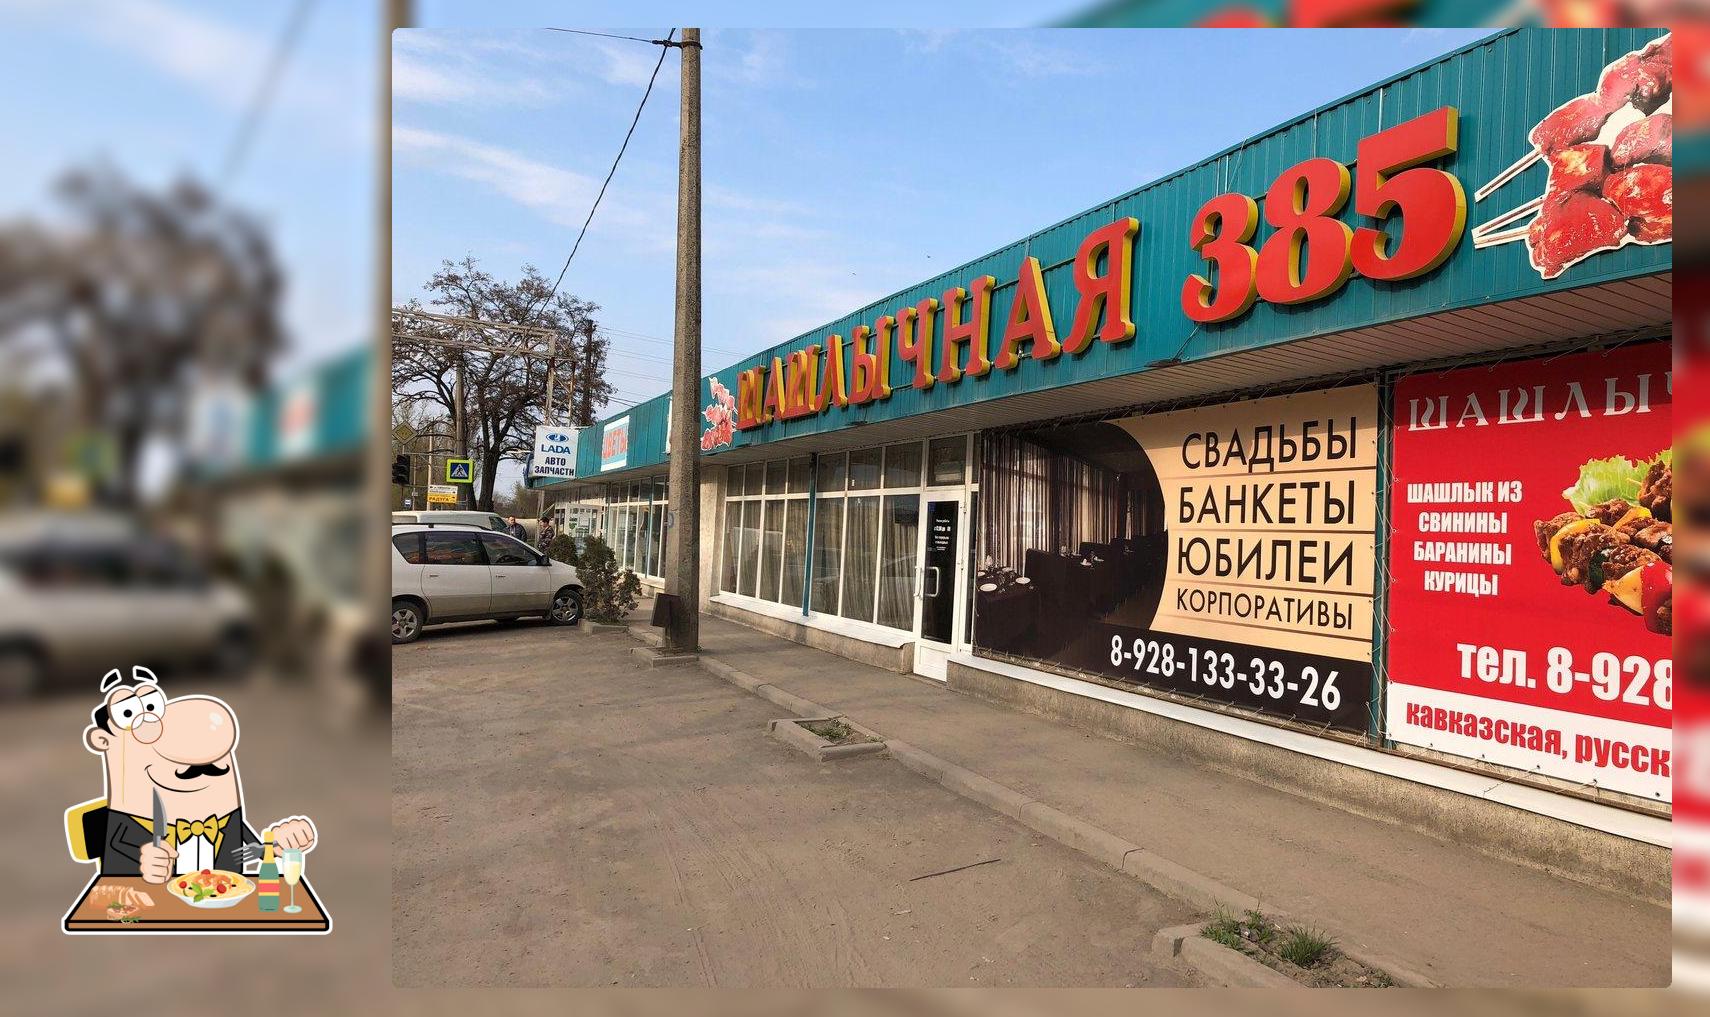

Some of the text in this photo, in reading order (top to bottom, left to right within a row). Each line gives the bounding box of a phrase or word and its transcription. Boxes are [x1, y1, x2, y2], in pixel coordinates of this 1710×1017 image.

[736, 105, 1467, 430] ШАШЛЫЧНАЯ 385
[541, 444, 571, 455] LADA
[545, 457, 566, 467] АВТО
[1182, 416, 1357, 473] СВАДЬБЫ
[534, 465, 575, 477] ЗАПЧАСТИ
[1407, 480, 1523, 503] ШАШЛЫК ИЗ
[1178, 480, 1355, 525] БАНКЕТЫ
[1418, 511, 1508, 534] СВИНИНЫ
[1177, 537, 1354, 586] ЮБИЛЕИ
[1413, 541, 1512, 565] БАРАНИНЫ
[1424, 570, 1499, 598] КУРИЦЫ
[1177, 588, 1353, 630] КОРПОРАТИВЫ
[1110, 635, 1341, 711] 8-928-133-33-26
[1456, 642, 1672, 711] тел. 8-928
[1406, 702, 1568, 759] кавказская,
